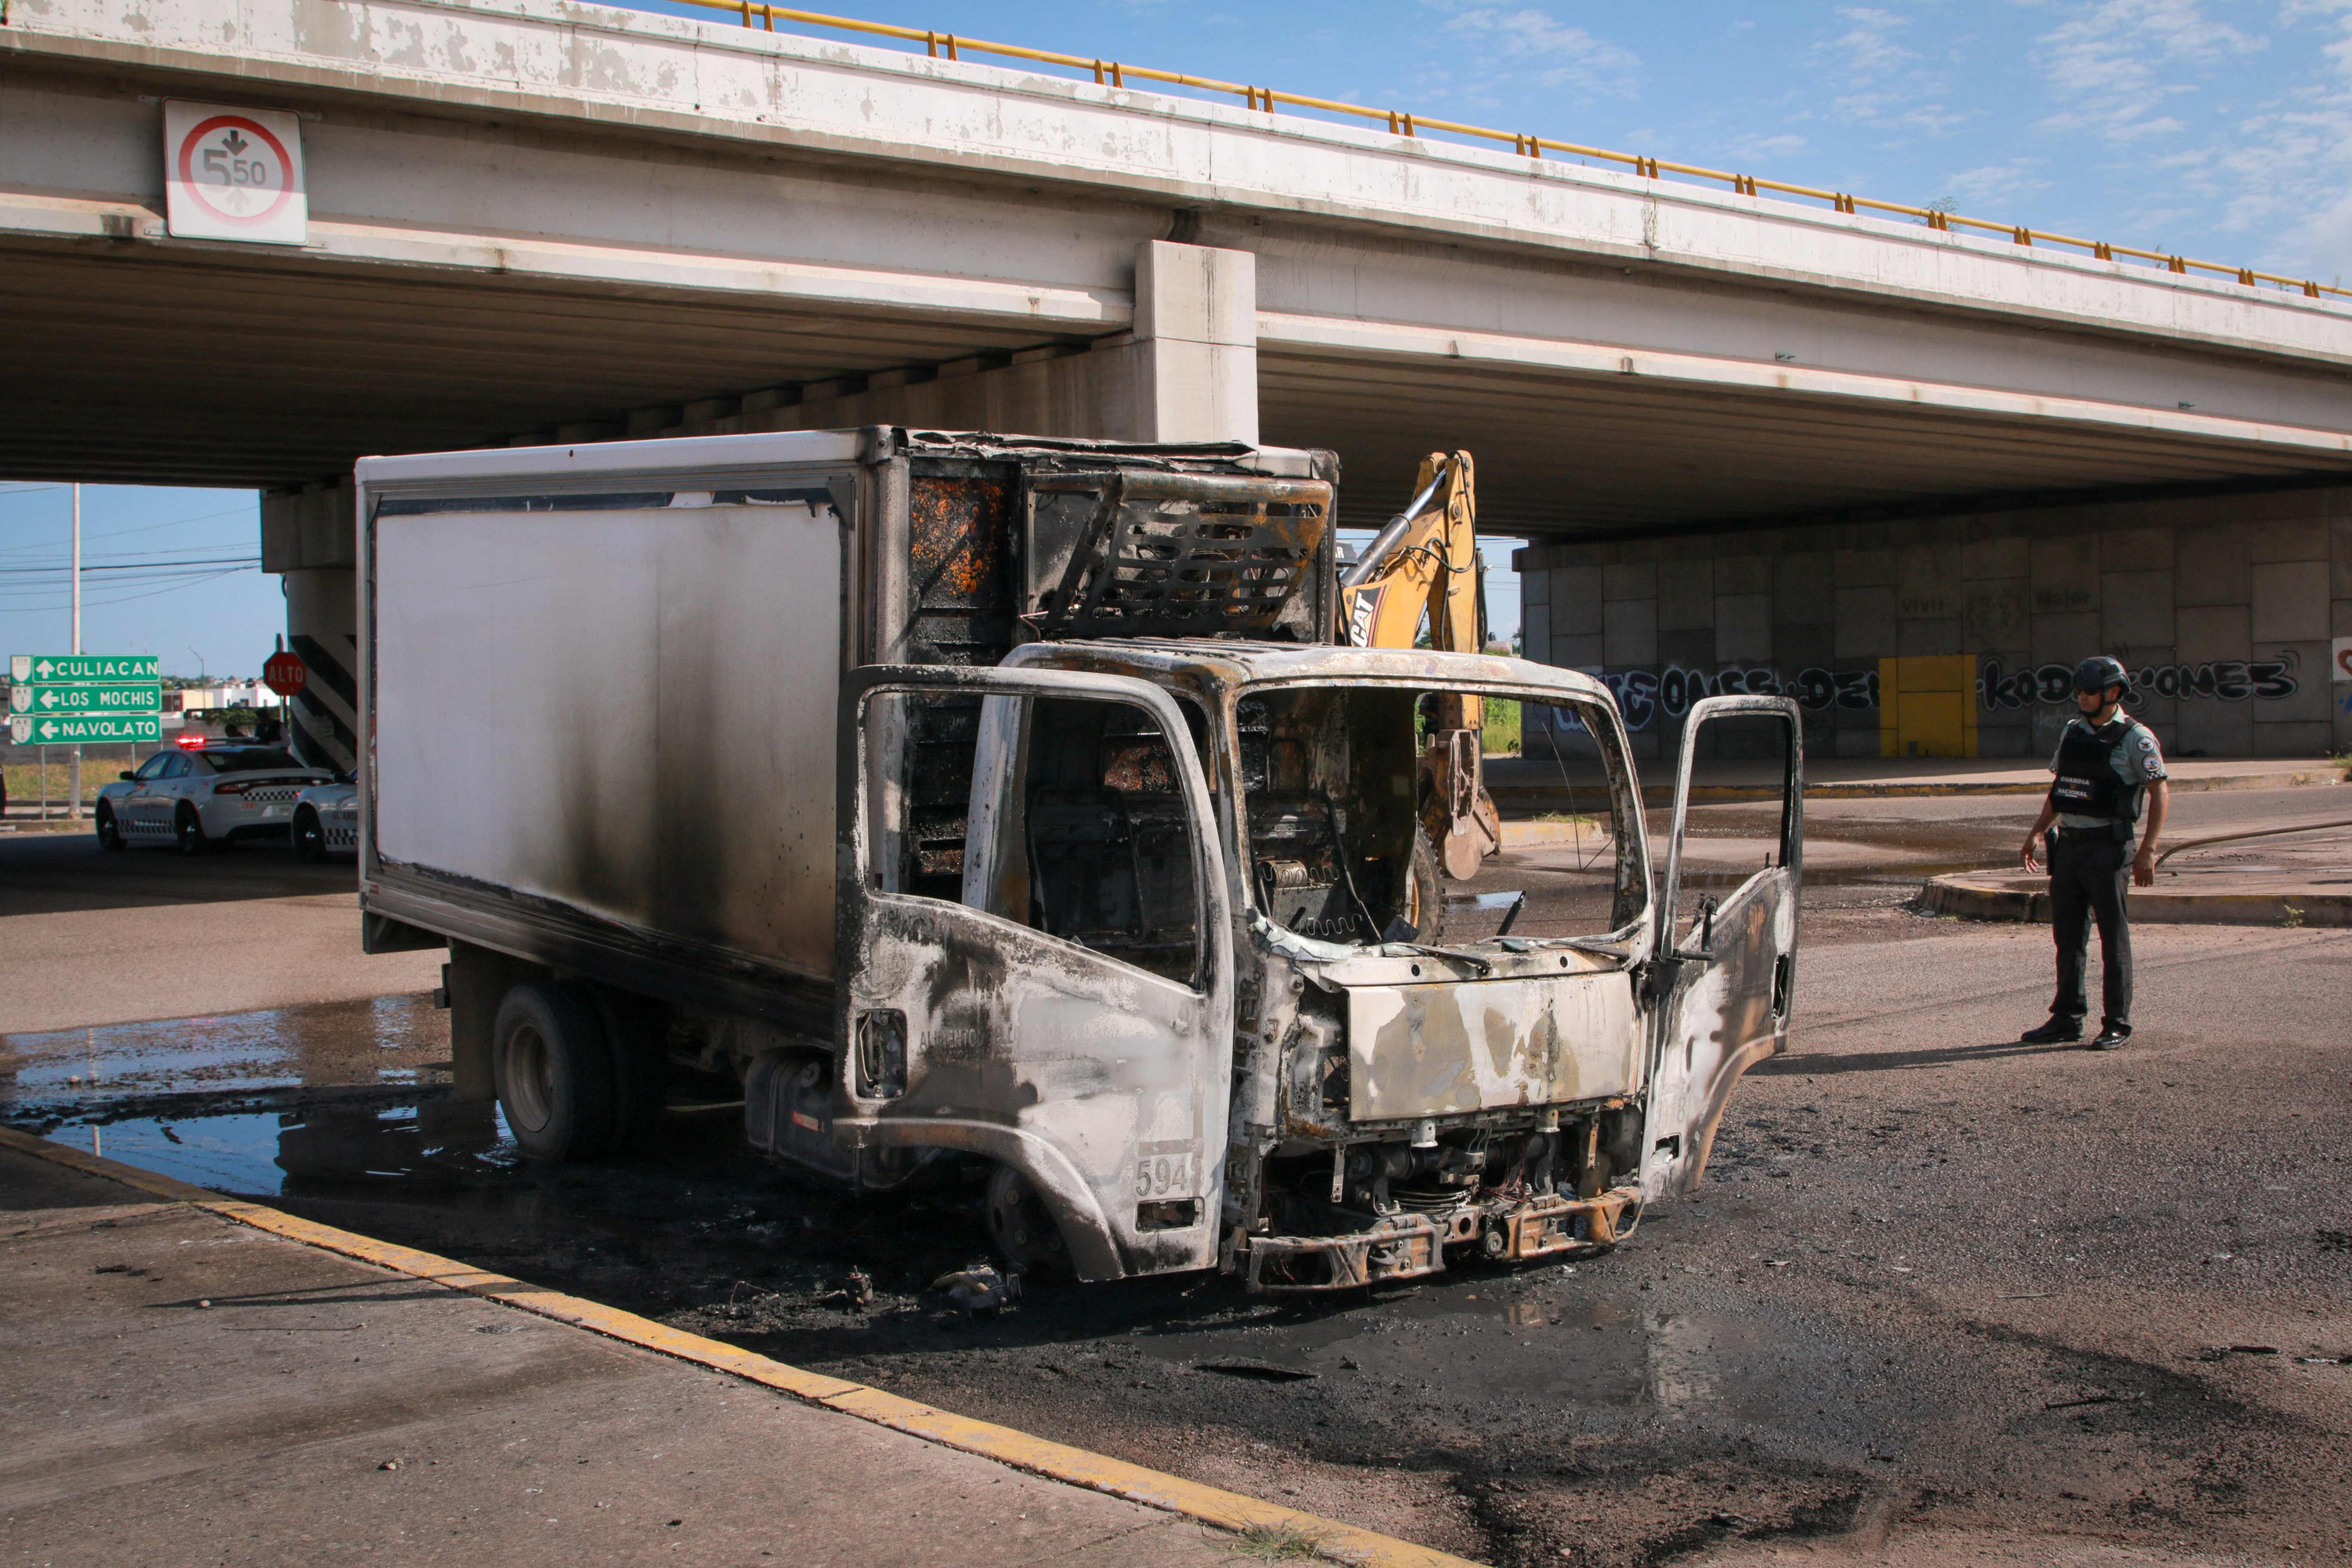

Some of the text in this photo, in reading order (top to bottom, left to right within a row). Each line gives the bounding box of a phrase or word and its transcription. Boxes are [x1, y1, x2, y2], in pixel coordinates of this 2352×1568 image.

[1350, 592, 1374, 647] CAT
[56, 662, 157, 676] CULIACAN
[269, 666, 303, 683] ALTO
[61, 691, 154, 706] LOS MOCHIS
[62, 721, 156, 736] NAVOLATO
[2060, 776, 2090, 785] GUARDIA
[2057, 788, 2088, 797] NACIONAL
[1136, 1158, 1187, 1197] 594
